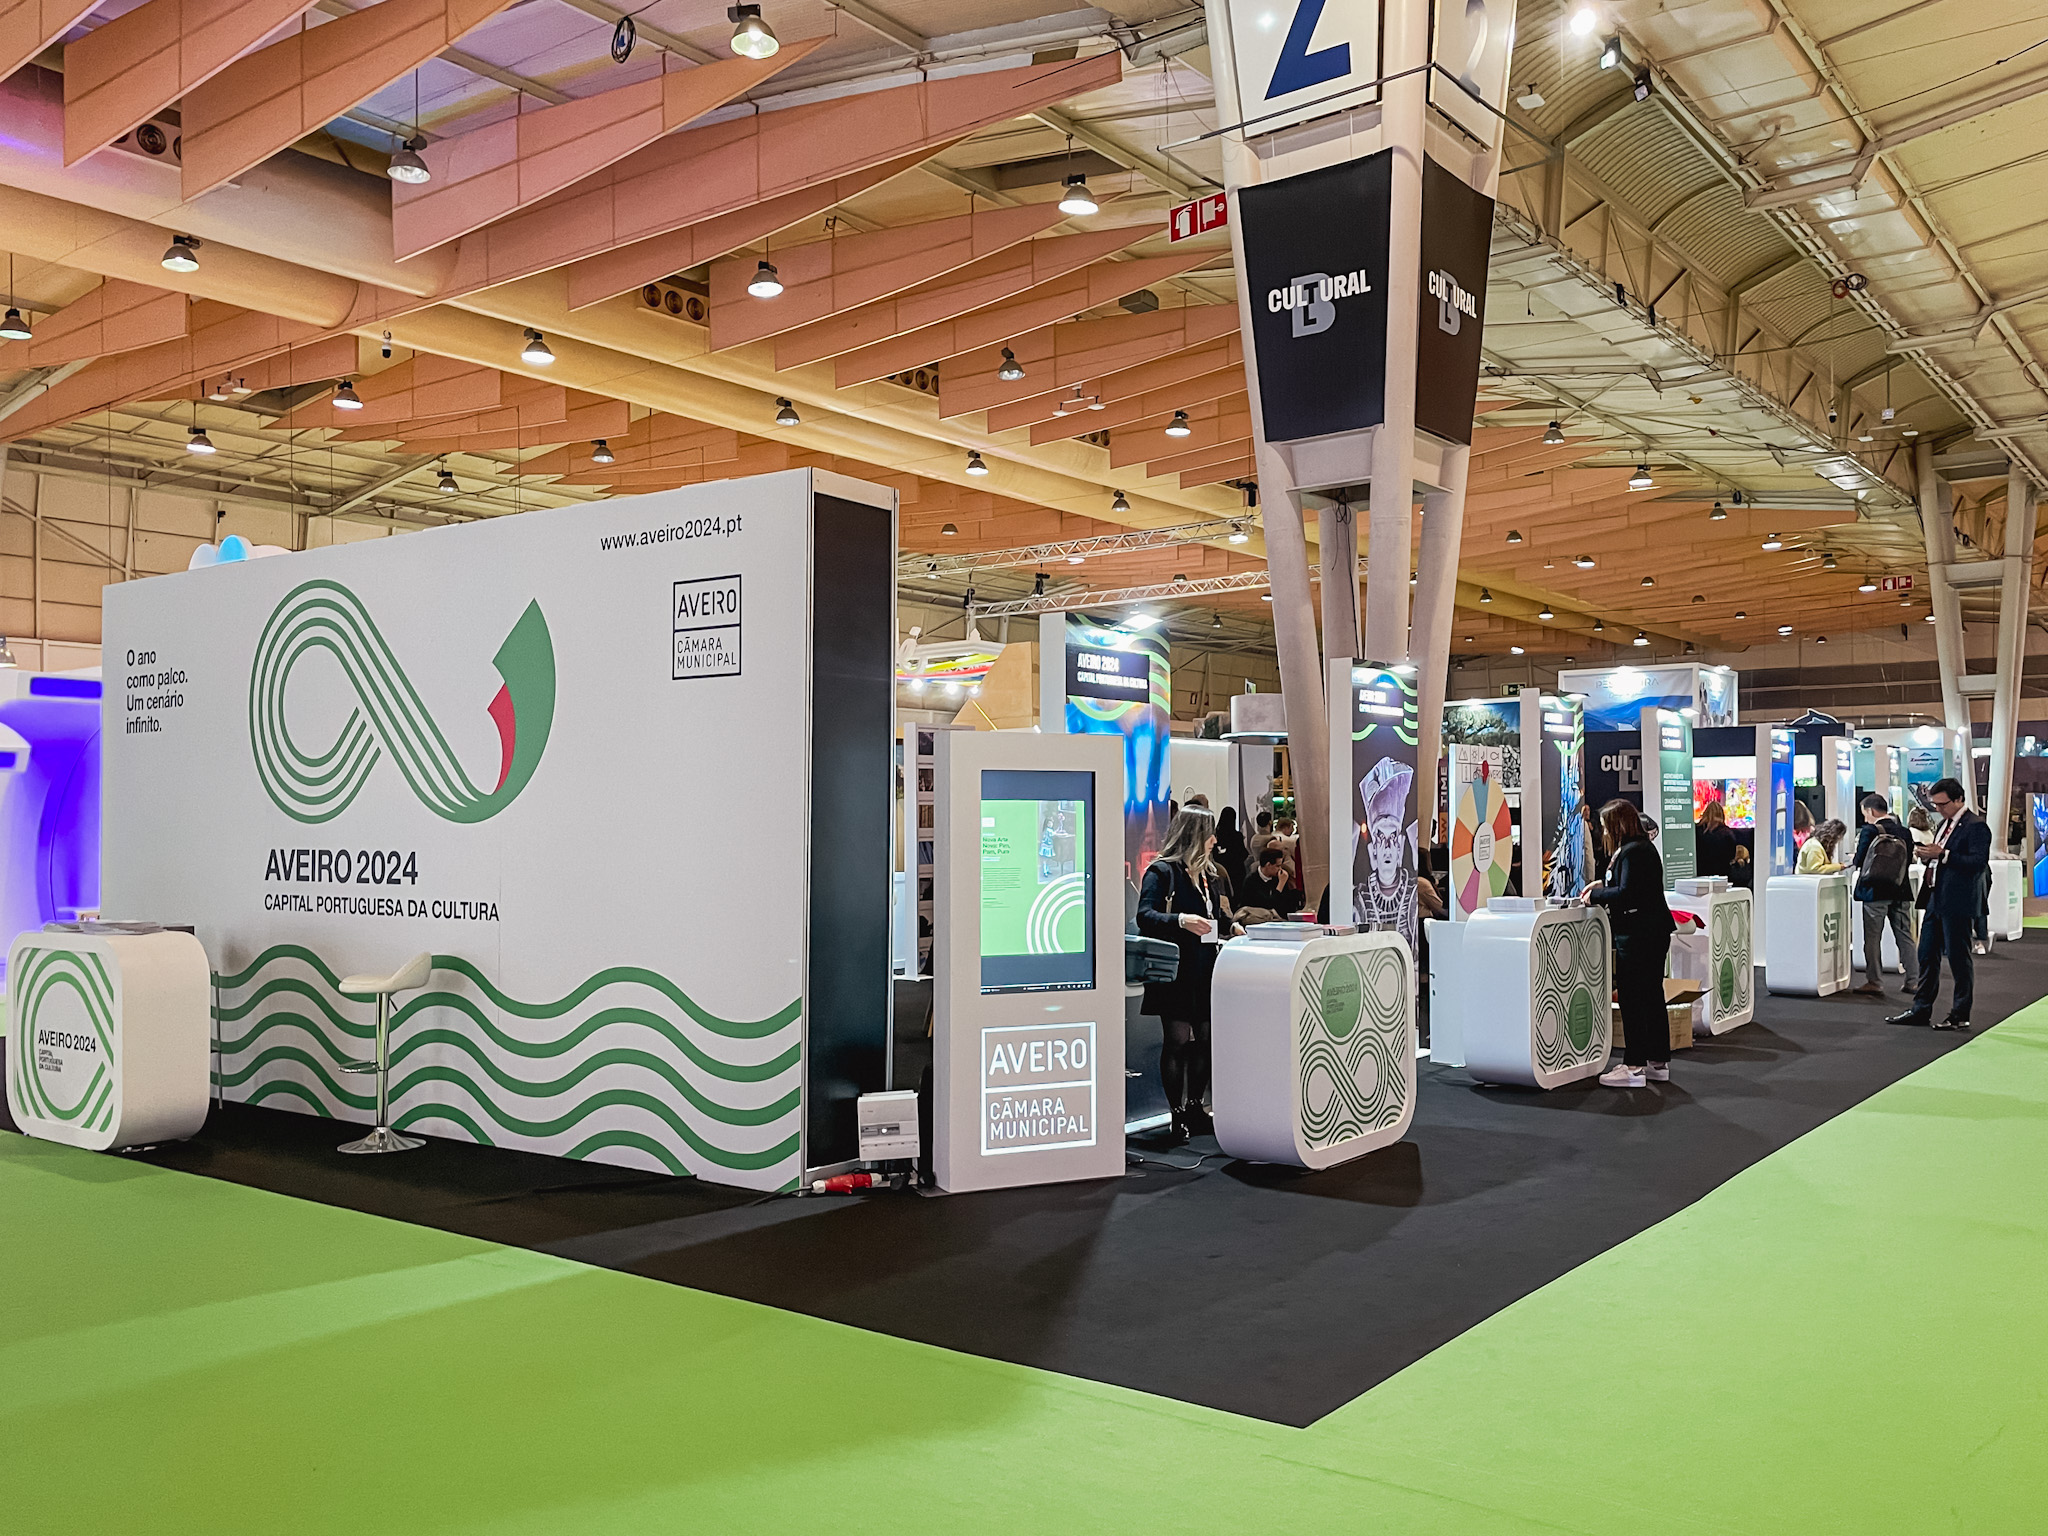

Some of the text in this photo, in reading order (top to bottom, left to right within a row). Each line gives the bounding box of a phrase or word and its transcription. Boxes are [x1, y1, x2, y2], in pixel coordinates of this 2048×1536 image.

[1268, 270, 1371, 313] CULTURAL
[1428, 271, 1477, 319] CULTURAL
[600, 514, 742, 550] www.aveiro2024.pt
[677, 589, 737, 618] AVEIRO
[126, 649, 156, 666] O ano
[677, 652, 736, 669] MUNICIPAL
[126, 667, 188, 690] como palco.
[126, 689, 183, 711] Um cenário
[126, 715, 162, 734] infinito.
[1440, 766, 1448, 807] TIME
[264, 849, 418, 885] AVEIRO 2024
[264, 894, 500, 921] CAPITAL PORTUGUESA DA CULTURA
[38, 1029, 96, 1053] AVEIRO 2024
[989, 1038, 1087, 1076] AVEIRO
[990, 1115, 1088, 1140] MUNICIPAL
